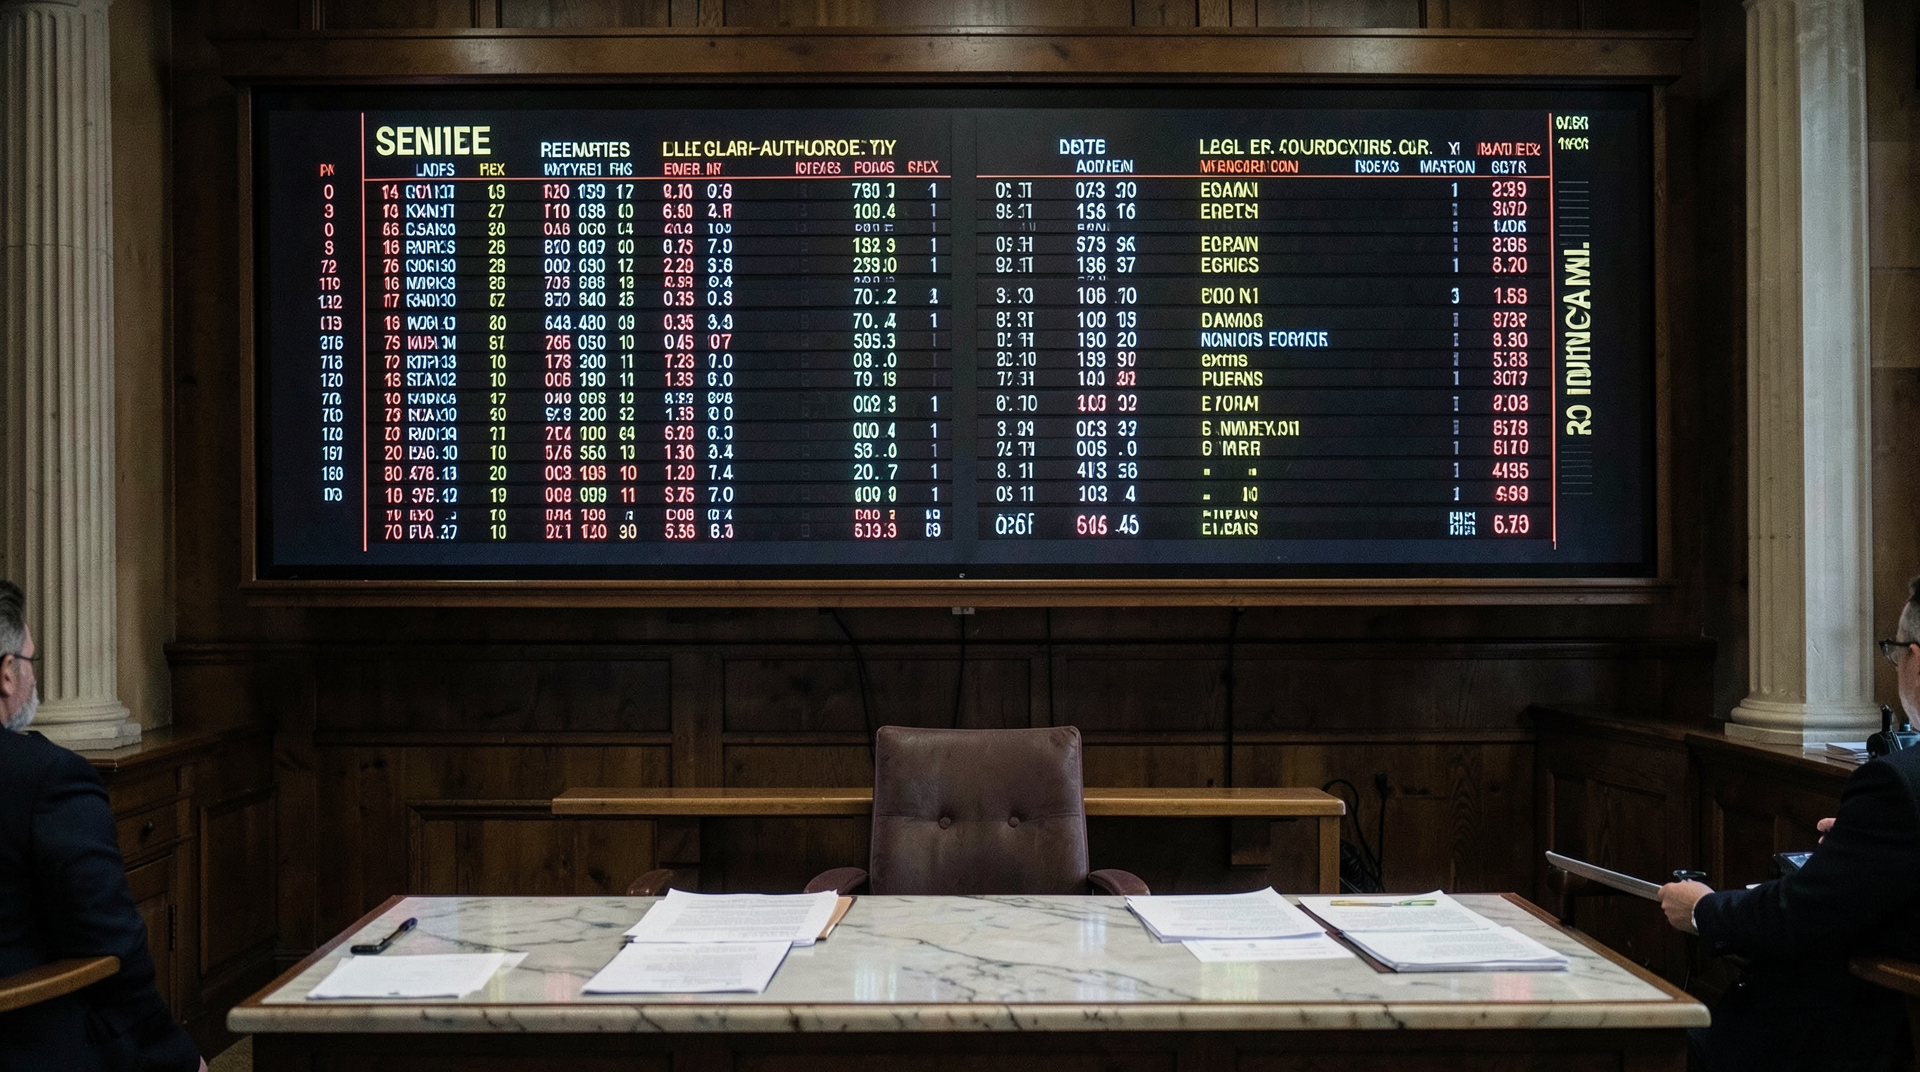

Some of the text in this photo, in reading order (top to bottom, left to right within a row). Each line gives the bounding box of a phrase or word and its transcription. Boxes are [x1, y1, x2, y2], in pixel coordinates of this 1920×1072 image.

[324, 184, 333, 199] 0
[928, 183, 936, 198] 1
[325, 223, 334, 237] 0
[931, 238, 936, 252] 1
[931, 257, 936, 272] 1
[1453, 258, 1458, 272] 1
[930, 313, 937, 327] 1
[619, 335, 634, 349] 10
[1117, 331, 1137, 347] 20
[490, 355, 506, 368] 10
[621, 355, 633, 368] 11
[490, 372, 506, 387] 10
[580, 408, 606, 421] 200
[931, 396, 937, 412] 1
[931, 423, 937, 438] 1
[385, 445, 402, 460] 20
[491, 445, 506, 460] 10
[490, 466, 506, 480] 20
[620, 465, 637, 480] 10
[709, 465, 733, 480] 7.4
[931, 463, 937, 479] 1
[621, 487, 635, 503] 11
[708, 487, 733, 502] 7.0
[932, 487, 937, 501] 1
[385, 524, 402, 539] 70
[491, 525, 506, 539] 10
